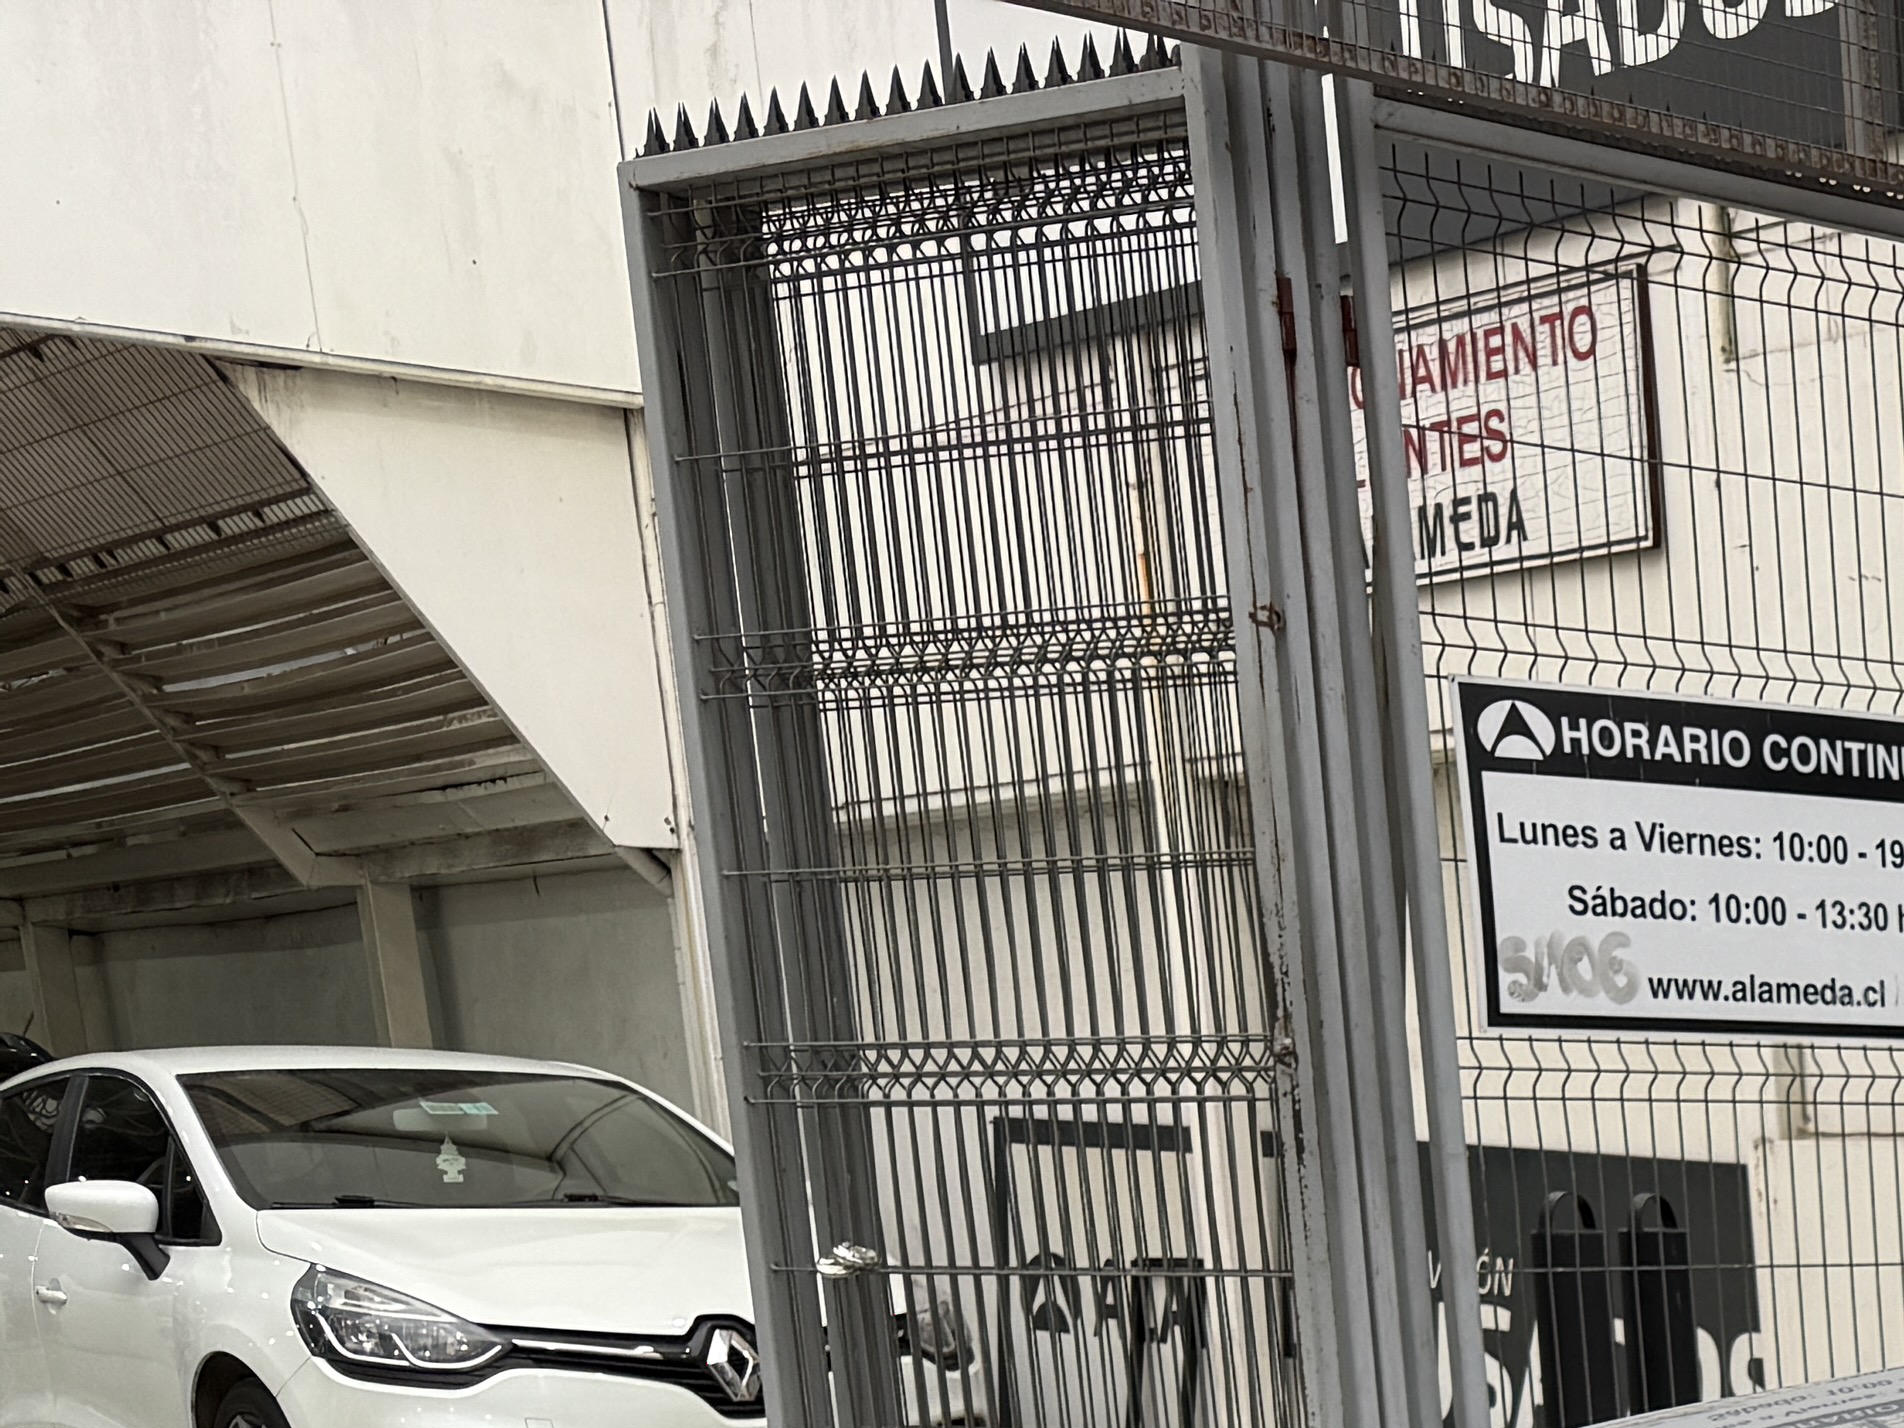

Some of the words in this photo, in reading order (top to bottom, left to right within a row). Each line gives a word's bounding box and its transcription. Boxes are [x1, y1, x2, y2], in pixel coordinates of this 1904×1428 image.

[1397, 304, 1598, 401] AMIENTO
[1402, 408, 1509, 480] NTES
[1417, 487, 1529, 561] MEDA
[1560, 715, 1751, 769] HORARIO
[1496, 811, 1599, 850] Lunes
[1609, 826, 1628, 852] a
[1634, 820, 1763, 860] Viernes:
[1772, 831, 1849, 866] 10:00
[1566, 884, 1698, 923] Sábado:
[1708, 892, 1788, 927] 10:00
[1815, 899, 1890, 933] 13:30
[1647, 974, 1887, 1009] www.alameda.cl
